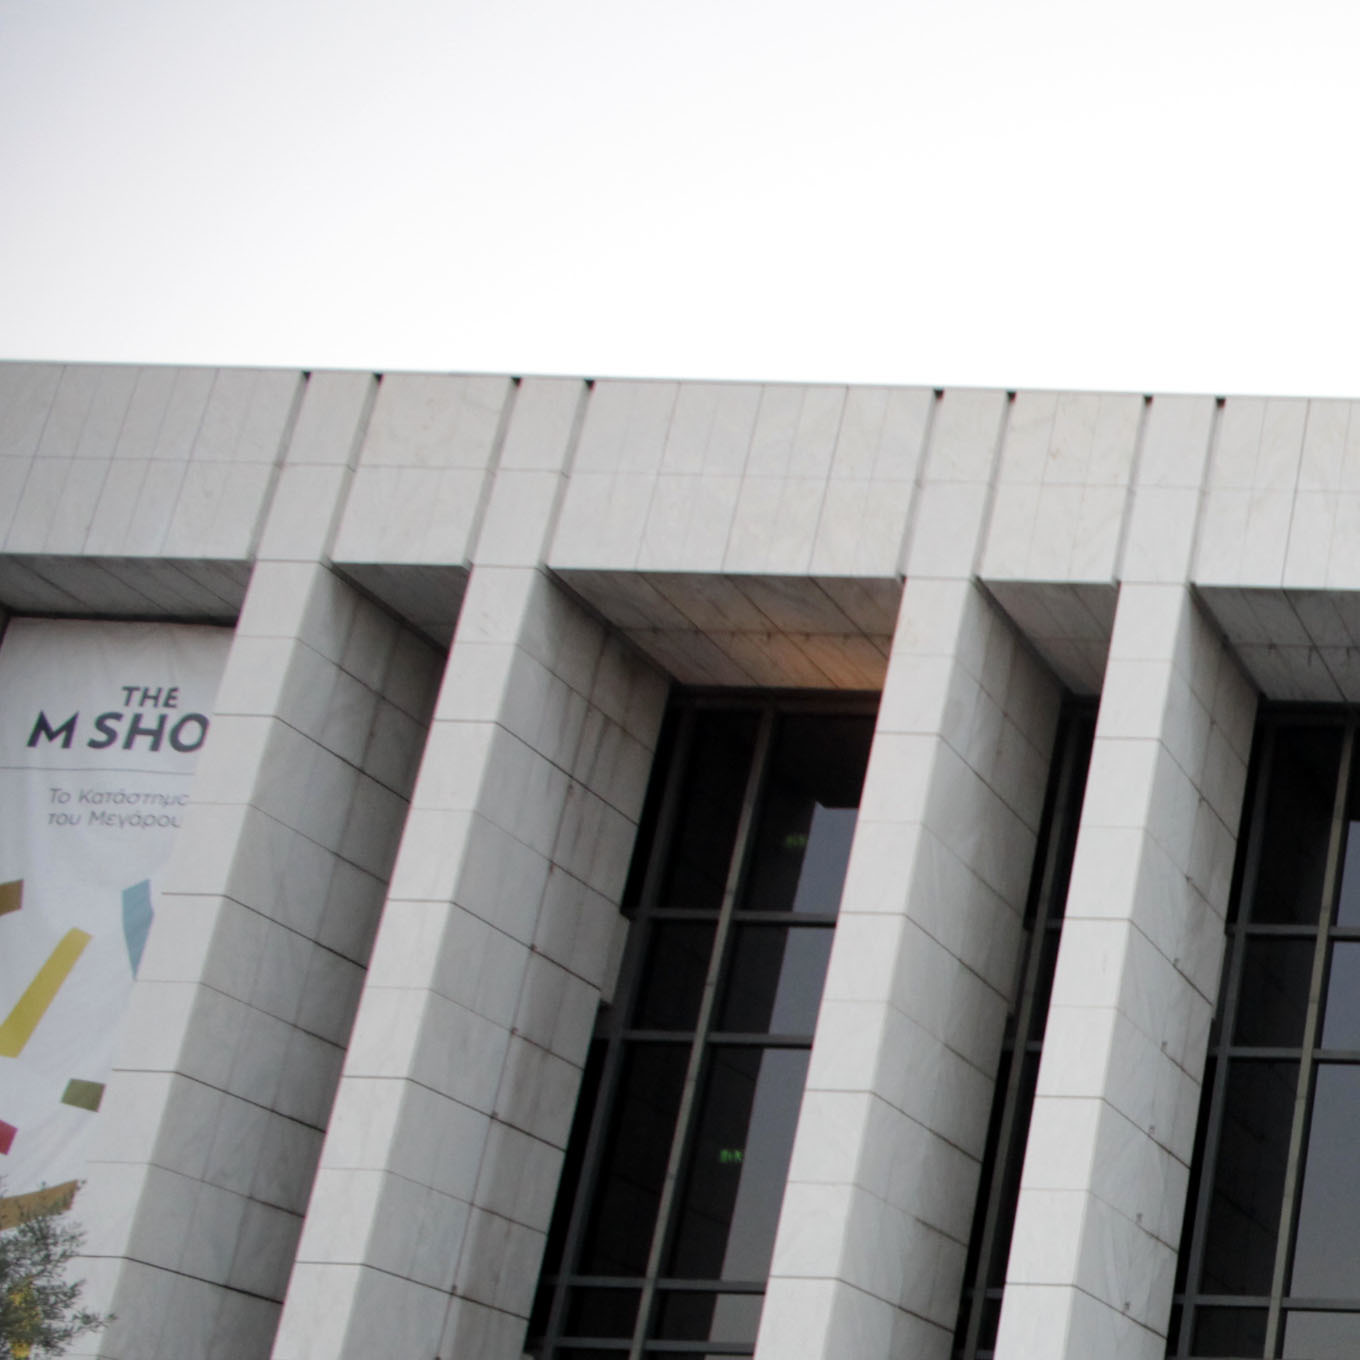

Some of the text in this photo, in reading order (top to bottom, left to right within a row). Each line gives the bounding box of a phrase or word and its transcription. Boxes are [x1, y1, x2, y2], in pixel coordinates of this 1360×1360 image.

[121, 685, 180, 709] THE
[26, 710, 211, 753] M SHO
[49, 788, 72, 805] Το
[48, 812, 81, 826] του
